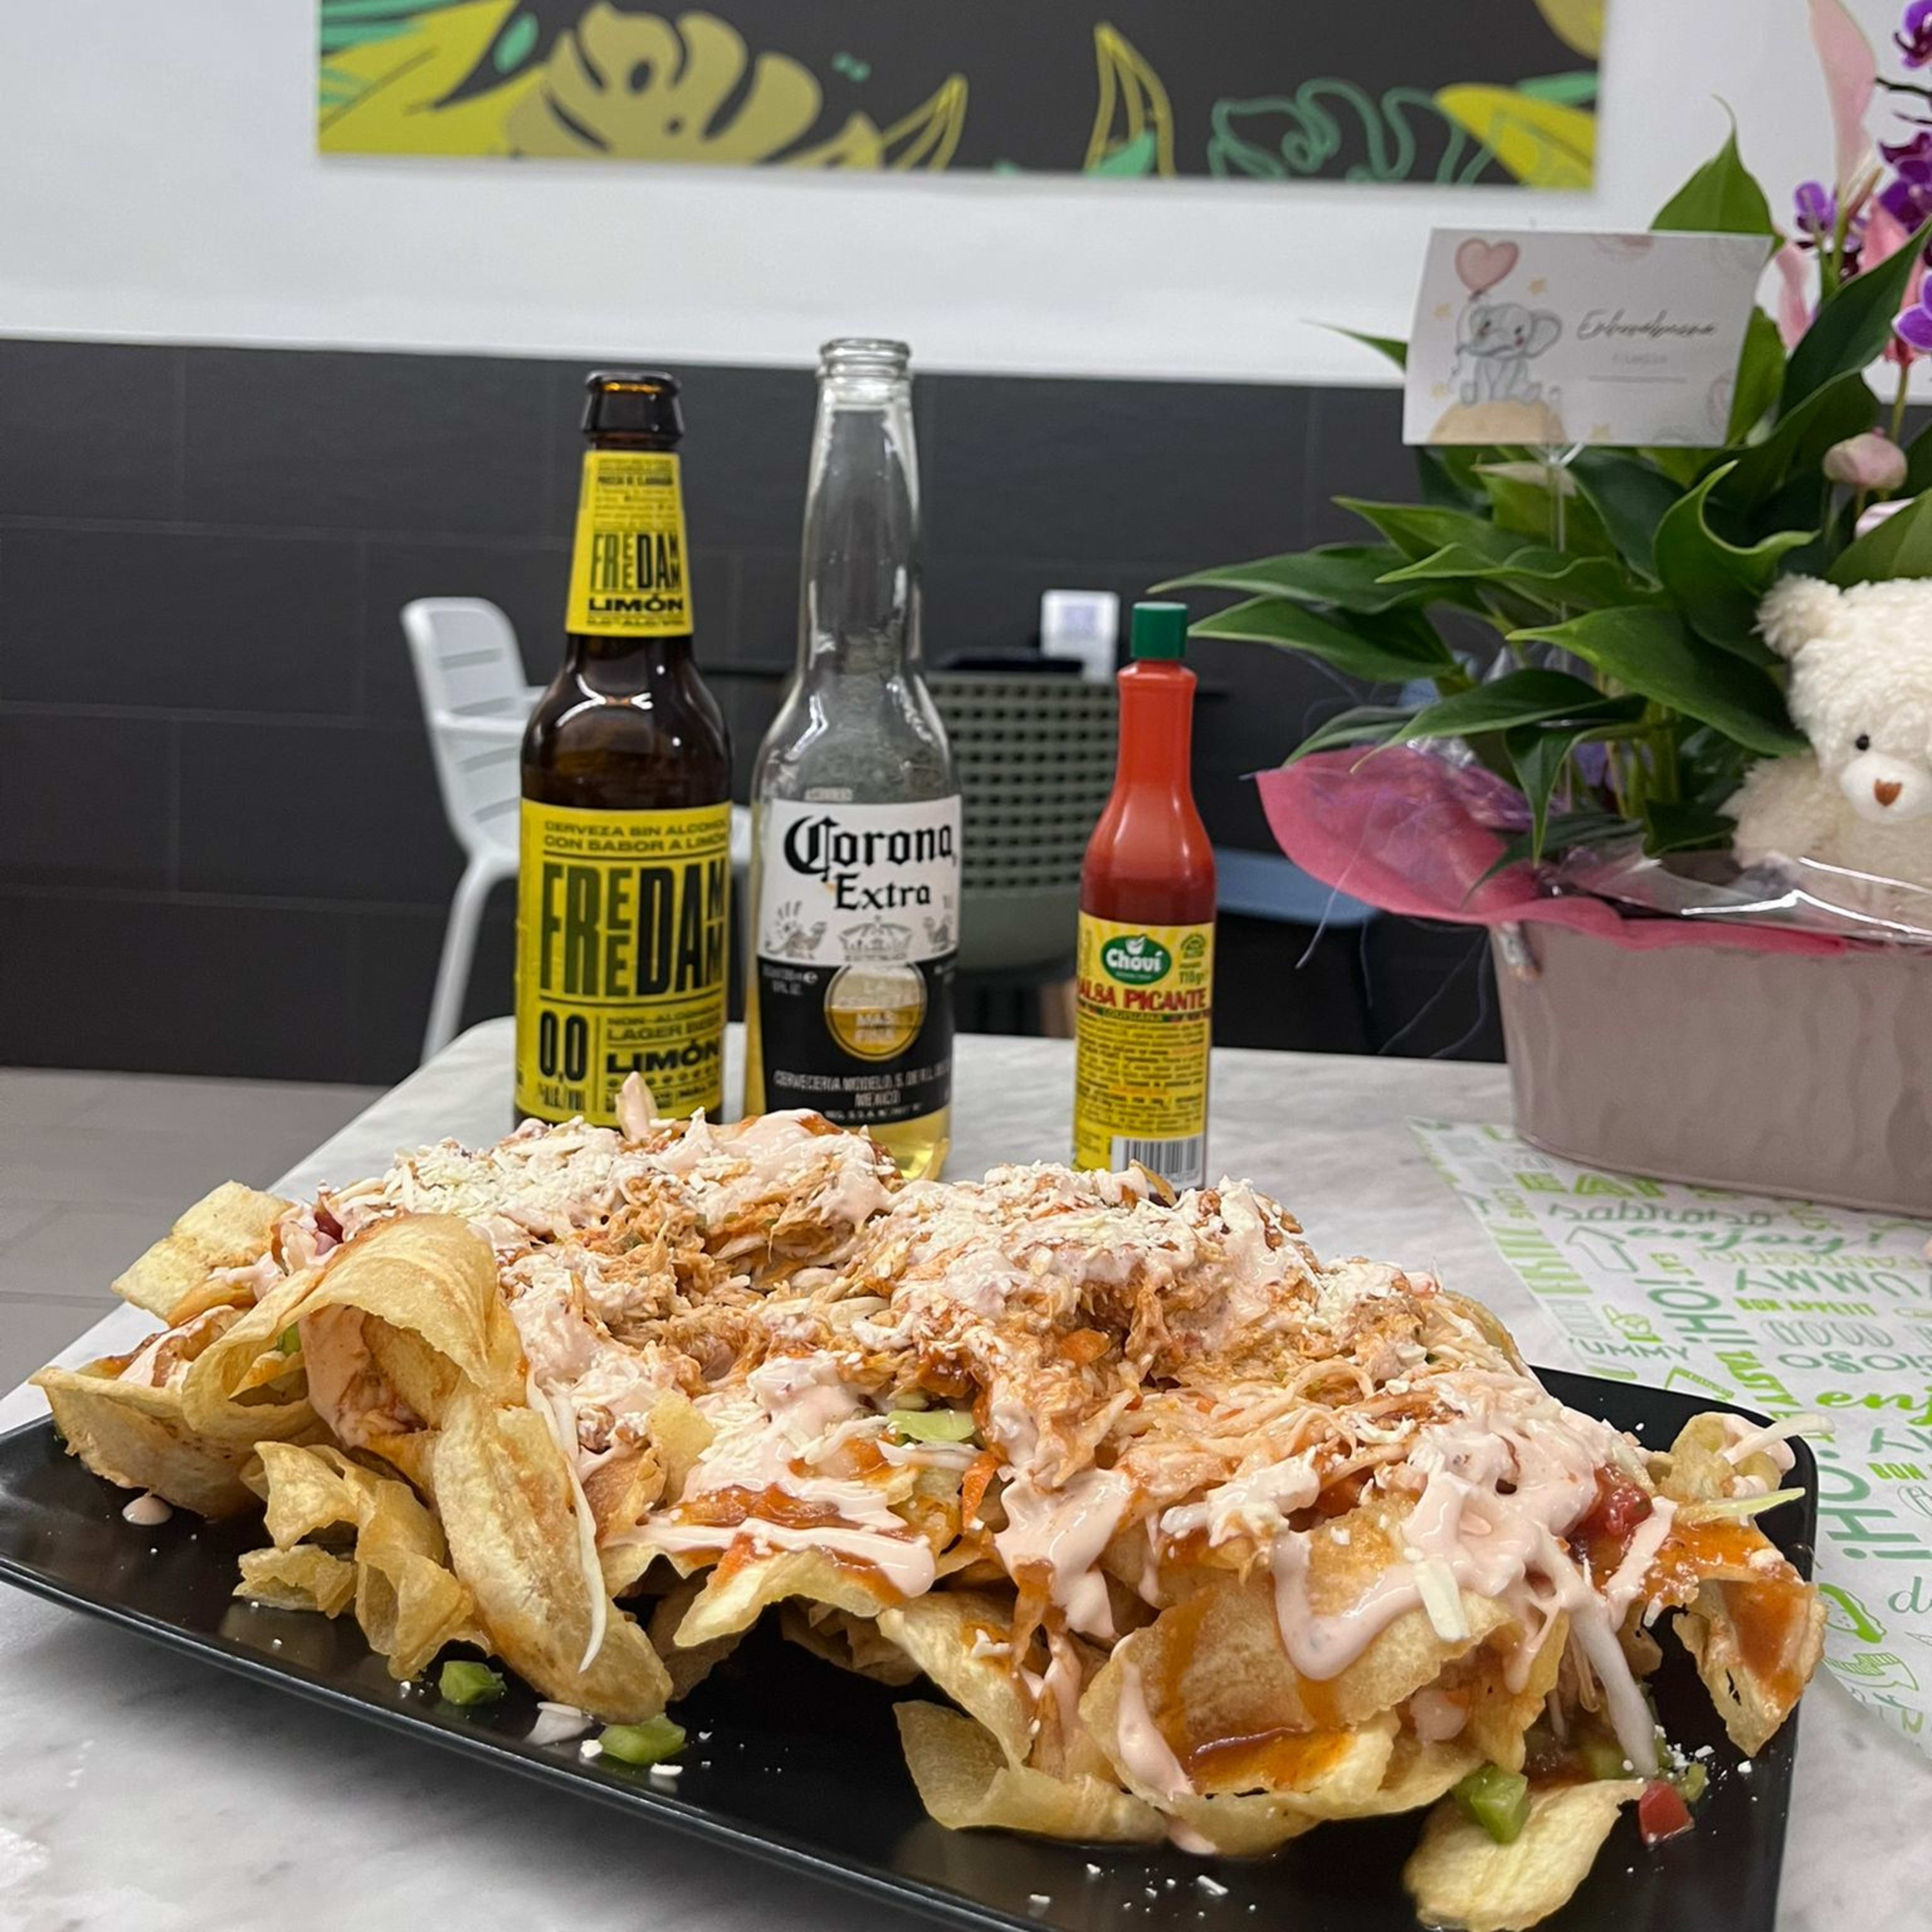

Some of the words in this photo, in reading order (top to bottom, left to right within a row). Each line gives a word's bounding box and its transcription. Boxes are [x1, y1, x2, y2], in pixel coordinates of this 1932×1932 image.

[589, 593, 684, 611] LIMÓN
[544, 820, 625, 836] CERVEZA
[544, 835, 583, 849] CON
[587, 838, 665, 852] SABOR
[784, 815, 957, 883] Corona
[834, 872, 931, 911] Extra
[1106, 947, 1162, 973] Choví
[1078, 977, 1117, 1007] ALSA
[1123, 987, 1207, 1011] PICANTE
[606, 1039, 719, 1074] LIMÓN
[1735, 1268, 1932, 1297] UMMY
[1568, 1337, 1690, 1361] UMMY
